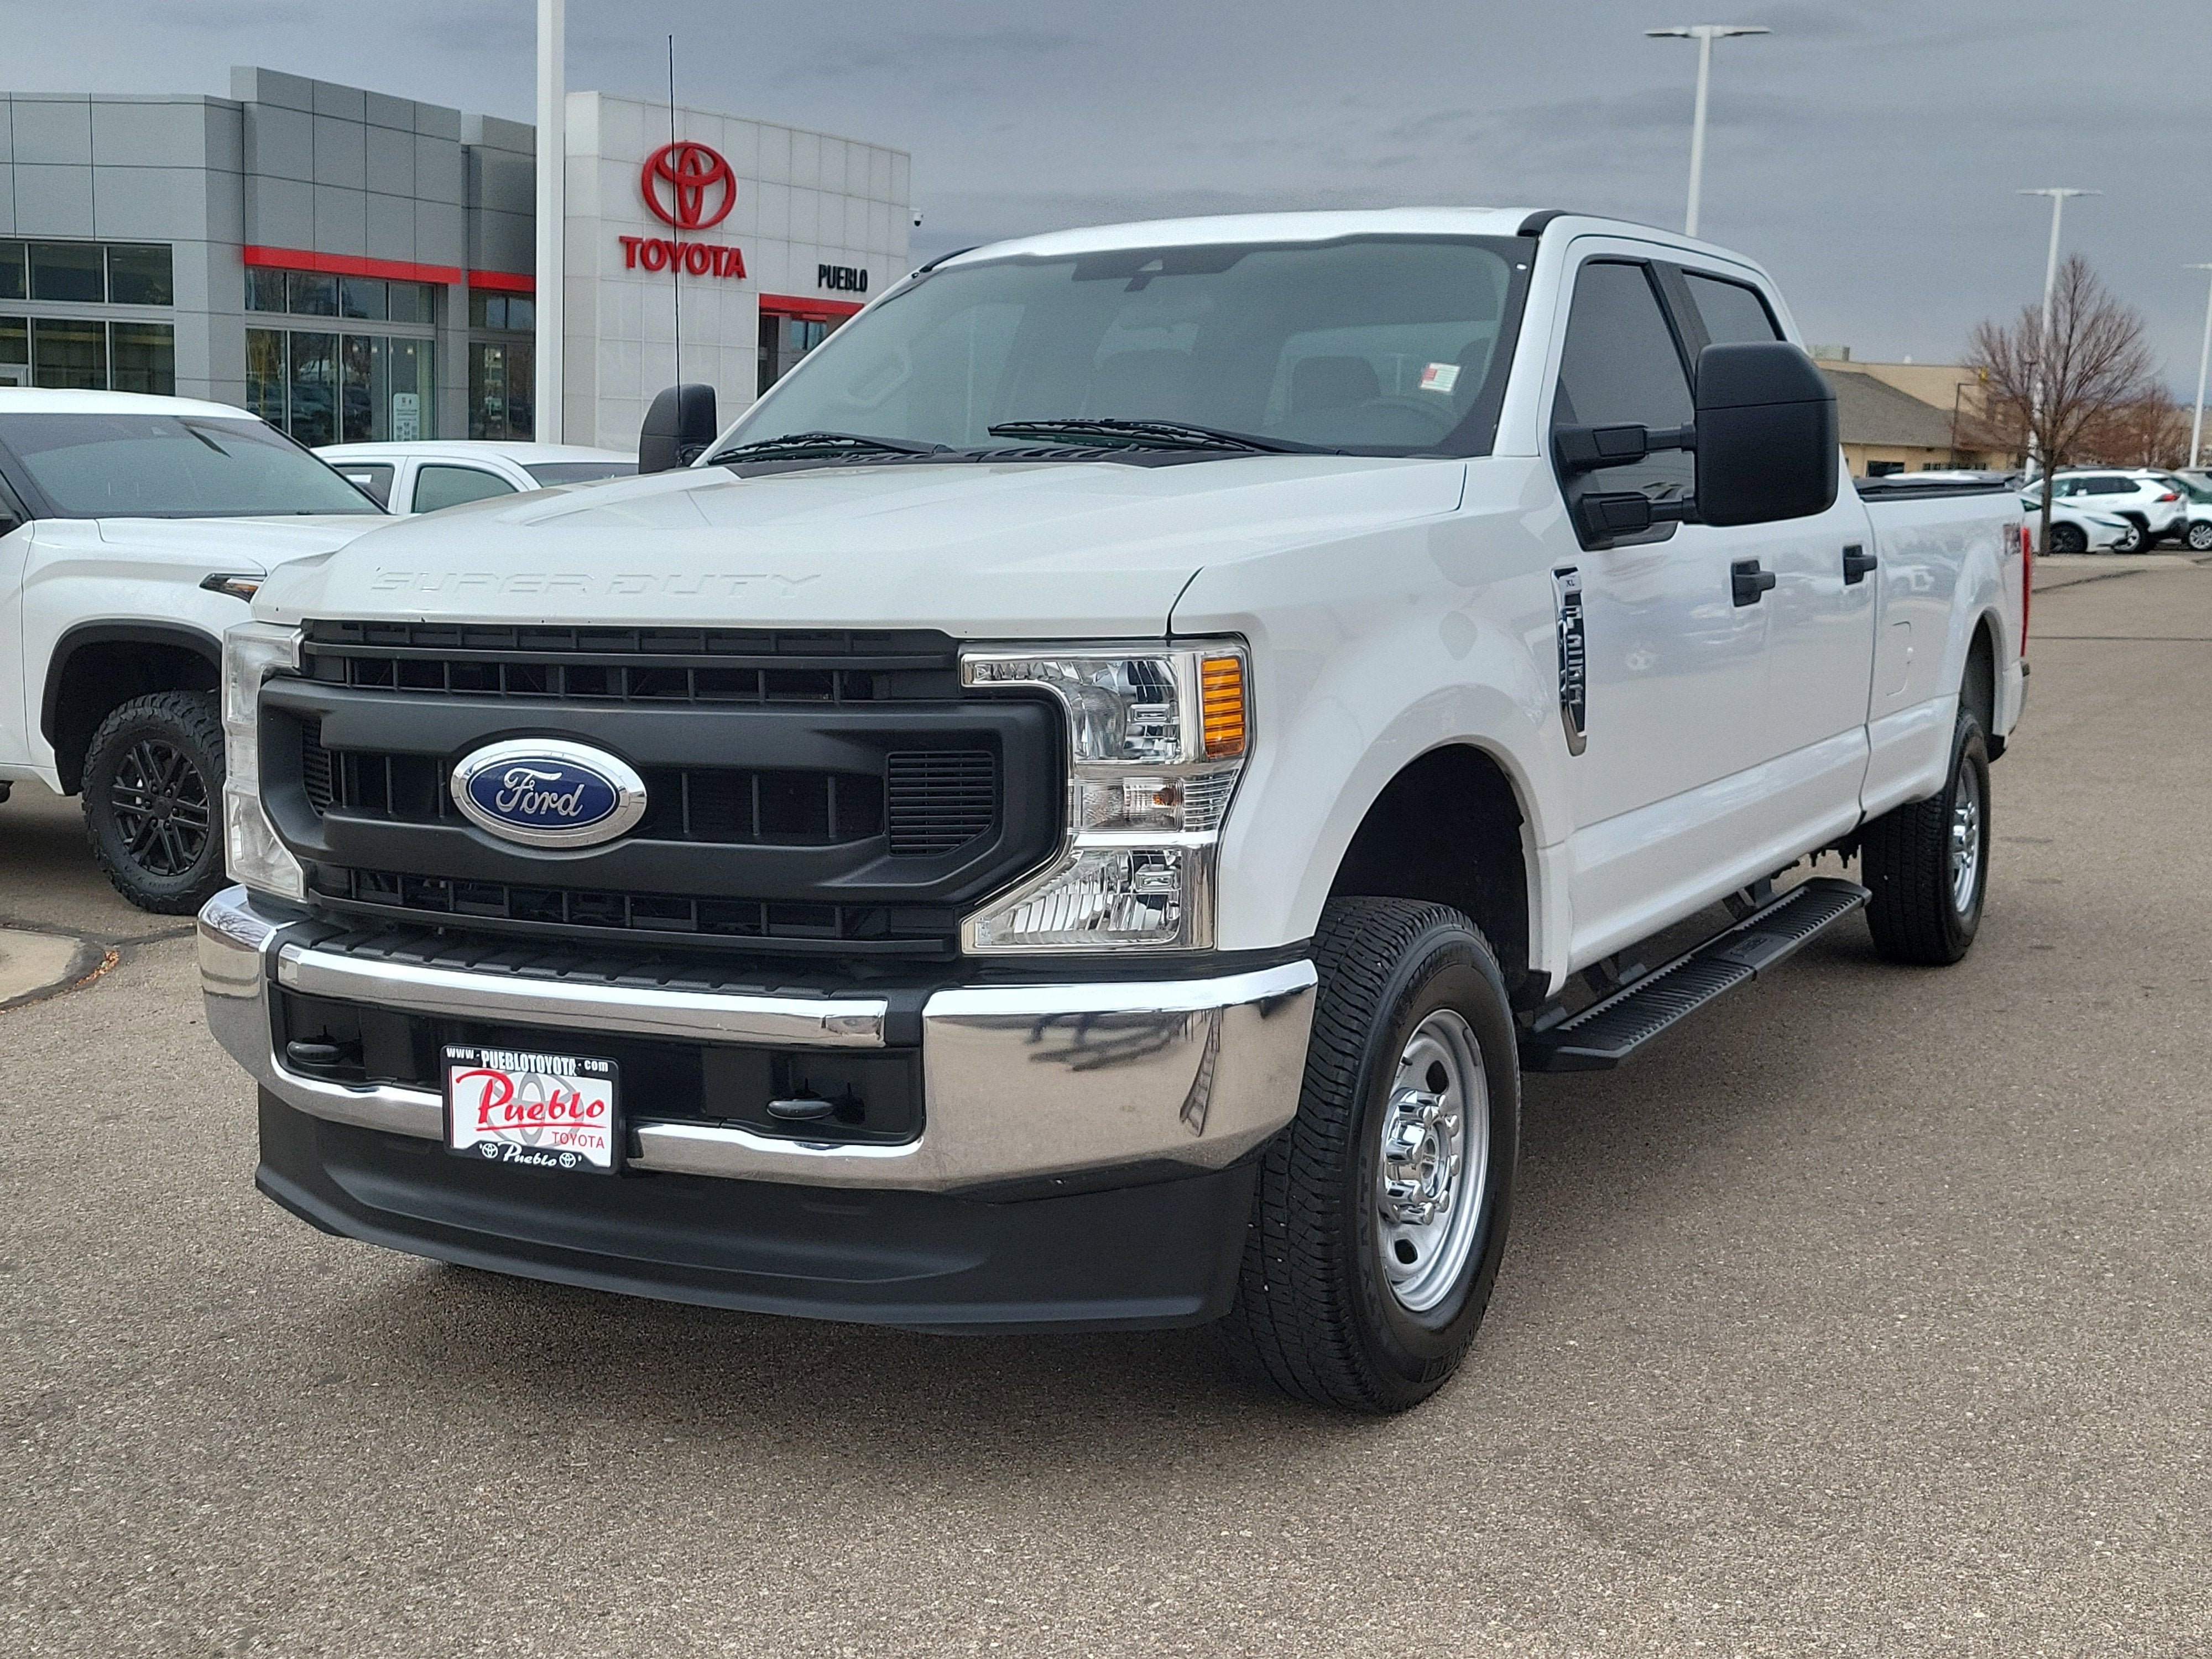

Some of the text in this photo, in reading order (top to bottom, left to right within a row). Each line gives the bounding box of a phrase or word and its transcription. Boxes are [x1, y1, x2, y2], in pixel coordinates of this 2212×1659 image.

[619, 236, 747, 279] TOYOTA
[818, 264, 868, 292] PUEBLO
[371, 572, 822, 597] SUPER DUTY
[496, 768, 585, 817] Ford
[455, 1068, 604, 1124] Pueblo
[498, 1141, 557, 1166] Pueblo
[552, 1131, 605, 1149] TOYOTA
